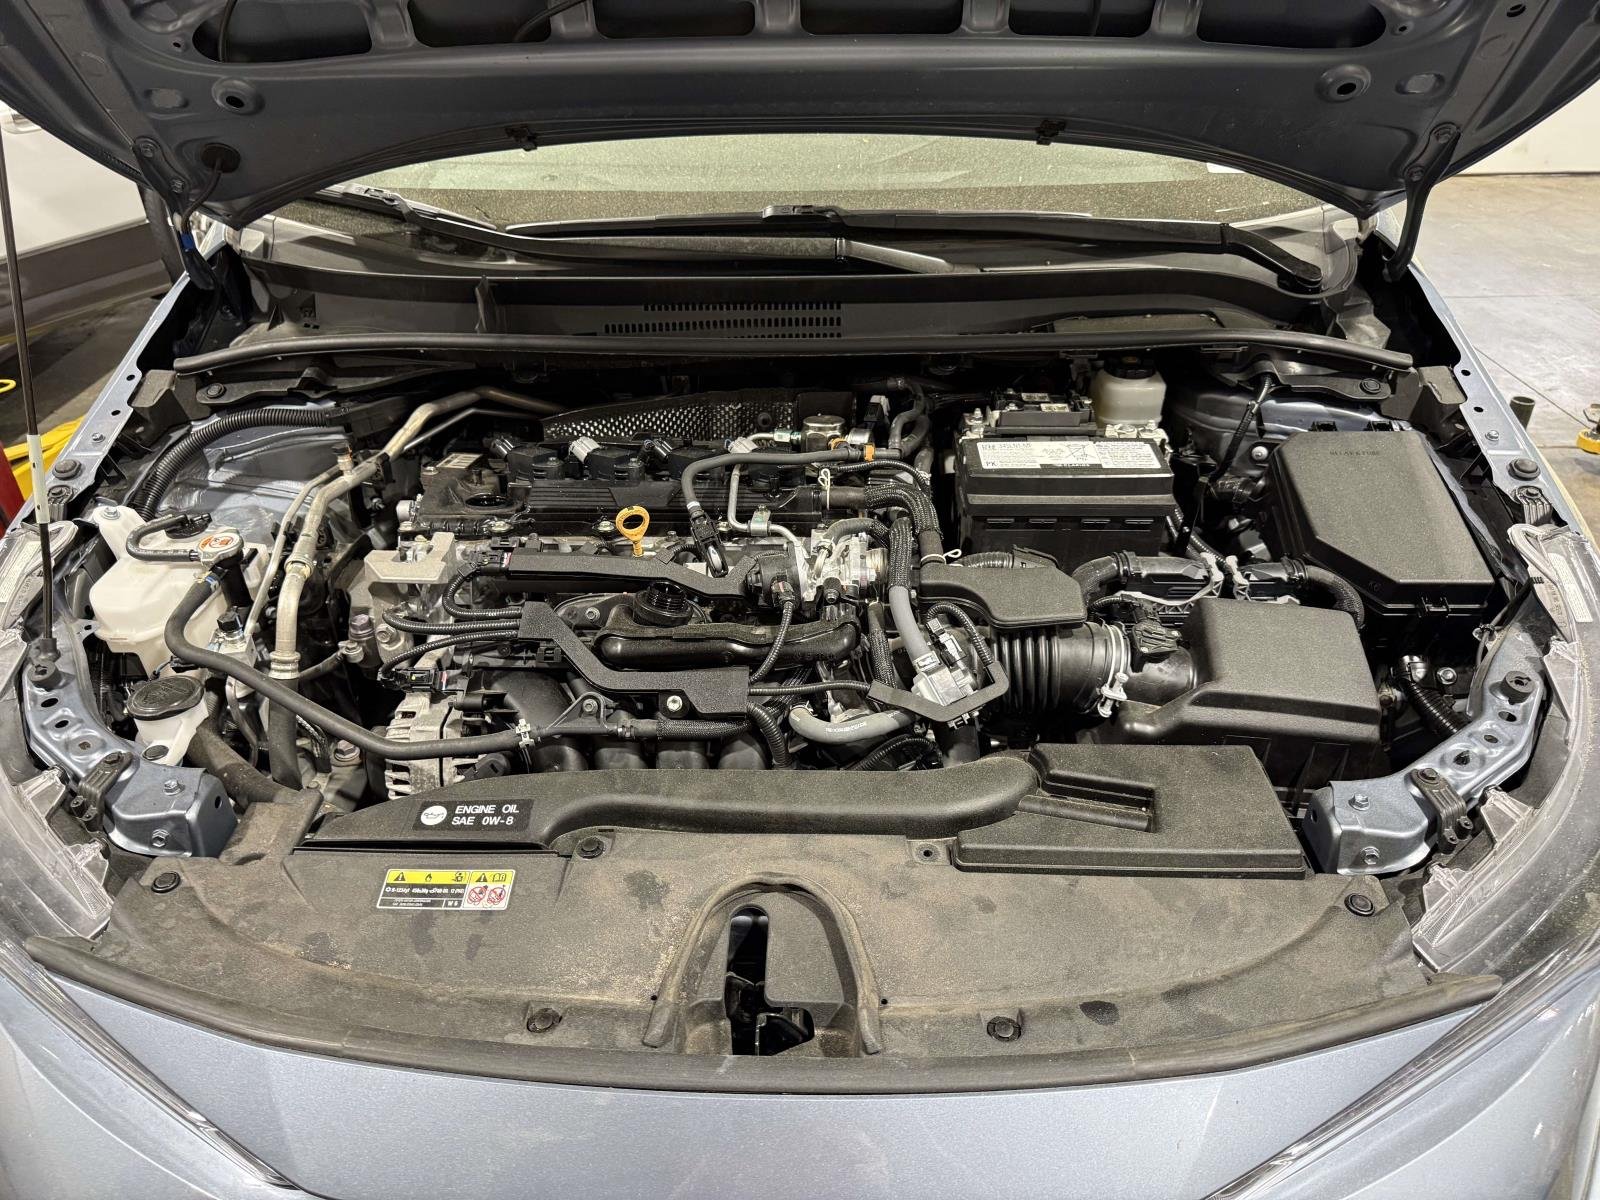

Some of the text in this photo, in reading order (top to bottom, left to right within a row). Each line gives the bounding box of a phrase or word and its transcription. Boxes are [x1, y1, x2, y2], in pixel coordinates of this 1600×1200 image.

[455, 804, 520, 814] ENGINE OIL
[451, 816, 514, 825] SAE 0W-8
